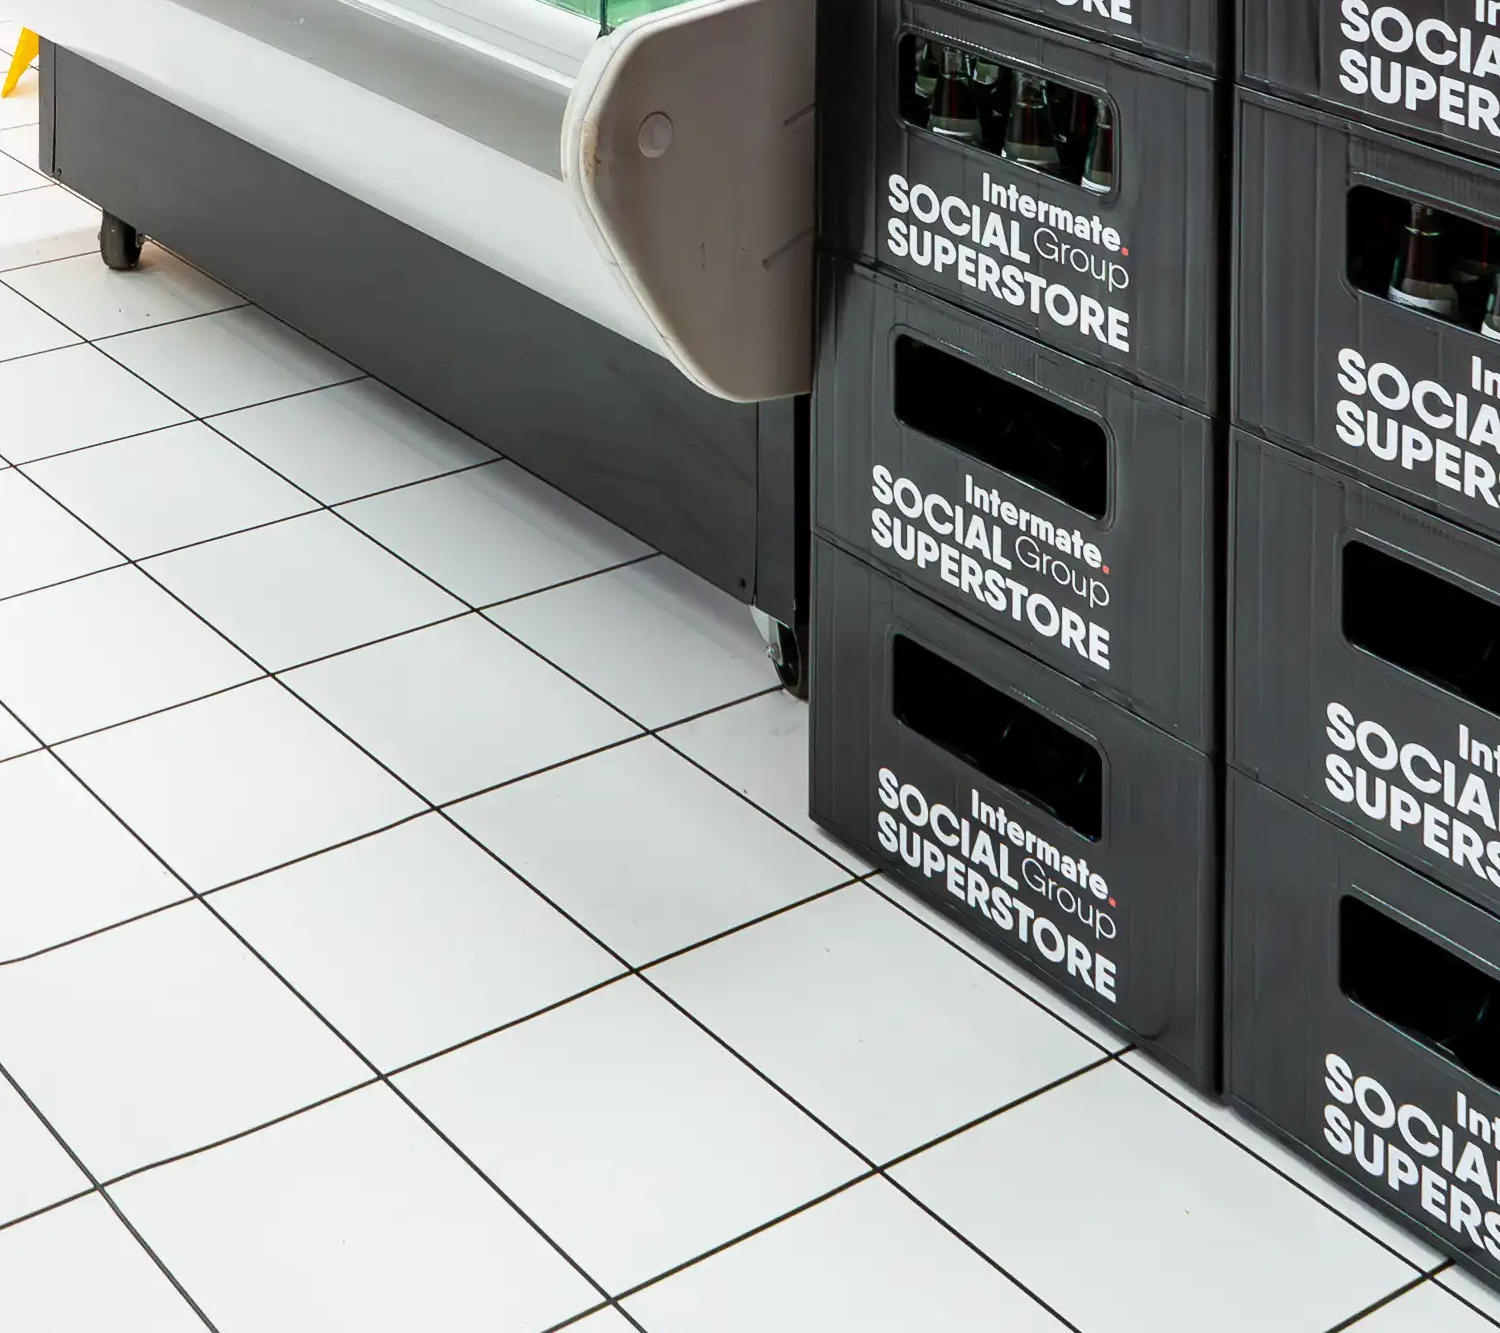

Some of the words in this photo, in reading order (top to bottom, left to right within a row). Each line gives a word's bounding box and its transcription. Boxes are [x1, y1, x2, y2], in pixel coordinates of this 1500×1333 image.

[889, 174, 1030, 263] SOCIAL
[983, 173, 1128, 256] Intermate.
[1034, 228, 1129, 292] Group
[888, 218, 1129, 352] SUPERSTORE
[872, 465, 1011, 570] SOCIAL
[966, 474, 1109, 574] Intermate.
[871, 508, 1110, 670] SUPERSTORE
[1015, 536, 1109, 608] Group
[878, 768, 1018, 890] SOCIAL
[972, 789, 1113, 899] Intermate.
[878, 811, 1116, 1003] SUPERSTORE
[1022, 858, 1116, 939] Group
